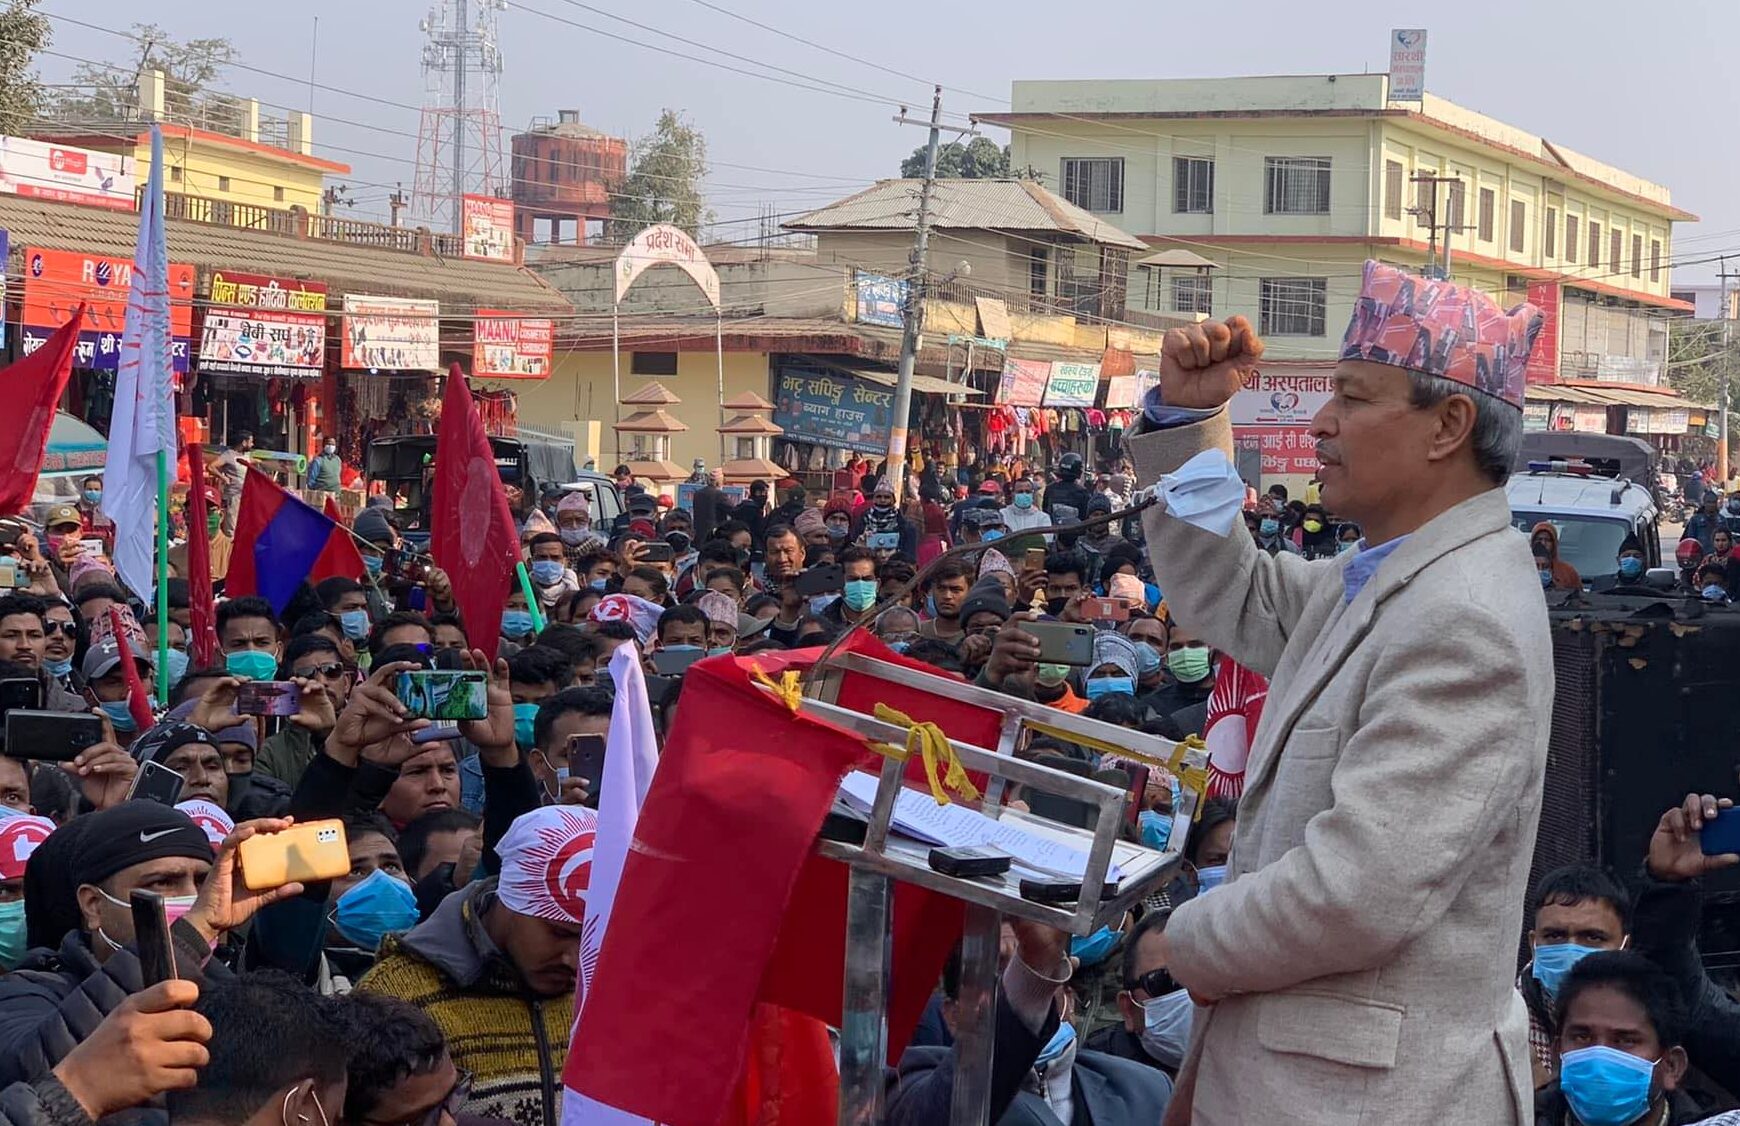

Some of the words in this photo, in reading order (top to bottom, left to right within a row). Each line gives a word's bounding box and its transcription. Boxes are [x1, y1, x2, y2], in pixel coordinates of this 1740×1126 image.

[646, 228, 673, 252] प्रदेश
[82, 259, 131, 286] ROYA
[242, 321, 265, 340] बेबी
[476, 319, 519, 343] MAANU
[1262, 375, 1327, 392] अस्पताल
[853, 384, 893, 408] सेन्टर
[835, 408, 865, 422] हाउस
[1262, 431, 1283, 450] आई
[1286, 430, 1296, 449] सी
